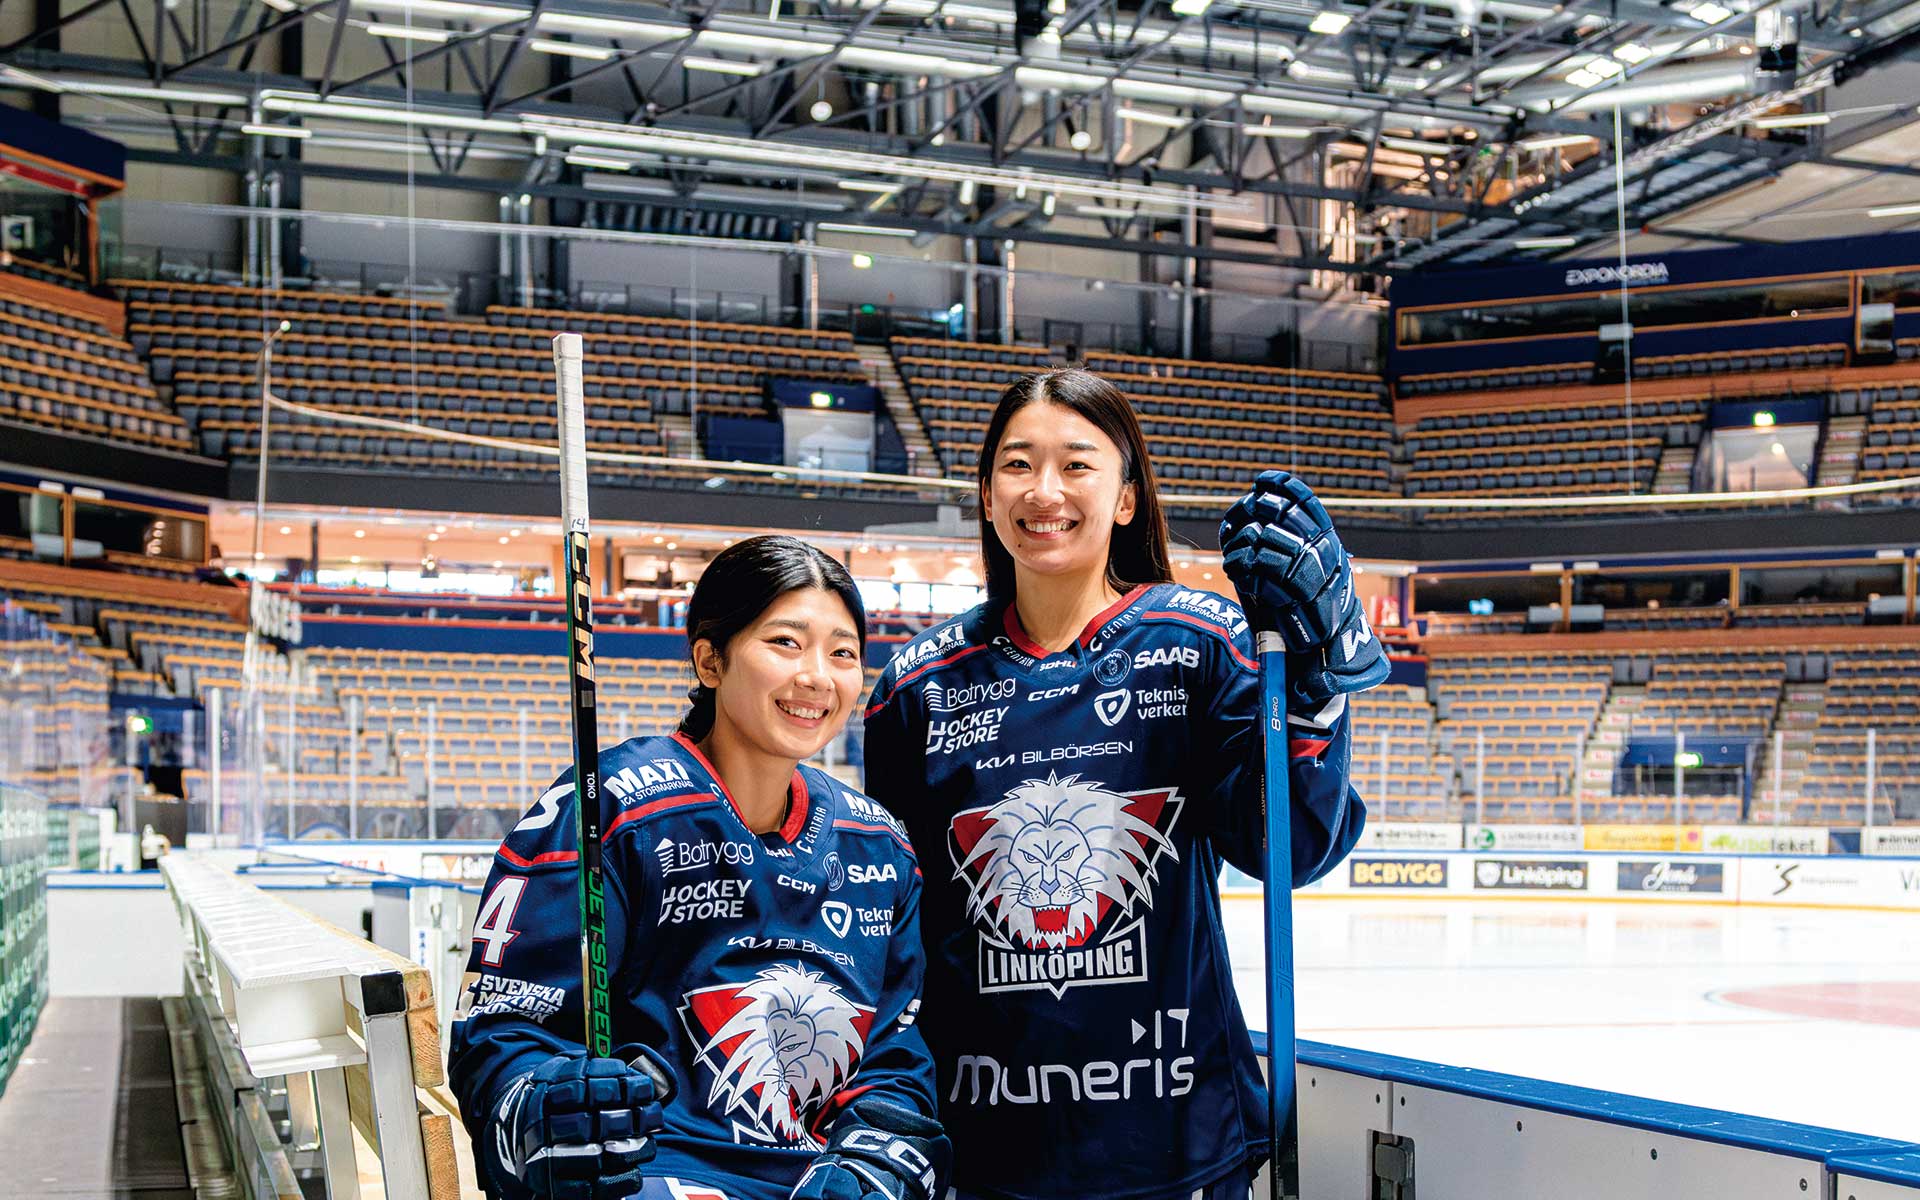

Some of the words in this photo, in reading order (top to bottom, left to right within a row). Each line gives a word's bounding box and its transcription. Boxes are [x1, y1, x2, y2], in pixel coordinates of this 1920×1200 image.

[571, 518, 586, 530] 14
[571, 531, 595, 683] CCM
[1170, 590, 1249, 636] MAXI
[1101, 605, 1143, 640] CENTRIA
[890, 624, 965, 677] MAXI
[907, 639, 966, 672] STORMARKNAD
[1002, 645, 1035, 668] CENTRIA
[1133, 646, 1201, 670] SAAB
[946, 677, 1016, 708] Botrygg
[1027, 683, 1080, 702] CCM
[1136, 685, 1189, 705] Teknis
[1271, 696, 1280, 718] PRO
[926, 705, 1010, 750] HOCKEY
[1270, 718, 1282, 732] 8
[943, 723, 1001, 755] STORE
[1022, 740, 1134, 765] BILBÖRSEN
[586, 772, 597, 799] TOKO
[603, 761, 690, 800] MAXI
[620, 796, 636, 807] ICA
[635, 780, 695, 801] STORMARKNAD
[806, 805, 828, 844] CENTRIA
[678, 838, 755, 866] Botrygg
[776, 874, 817, 895] CCM
[847, 863, 898, 884] SAA
[1353, 862, 1443, 884] BCBYGG
[1502, 862, 1584, 888] Linköping
[658, 879, 753, 912] HOCKEY
[472, 874, 529, 968] 4
[671, 899, 745, 924] STORE
[855, 904, 894, 922] Tekni
[859, 921, 892, 938] verk
[587, 868, 613, 1059] JETSPEED
[986, 938, 1135, 985] LINKÖPING
[480, 973, 567, 1007] SVENSKA
